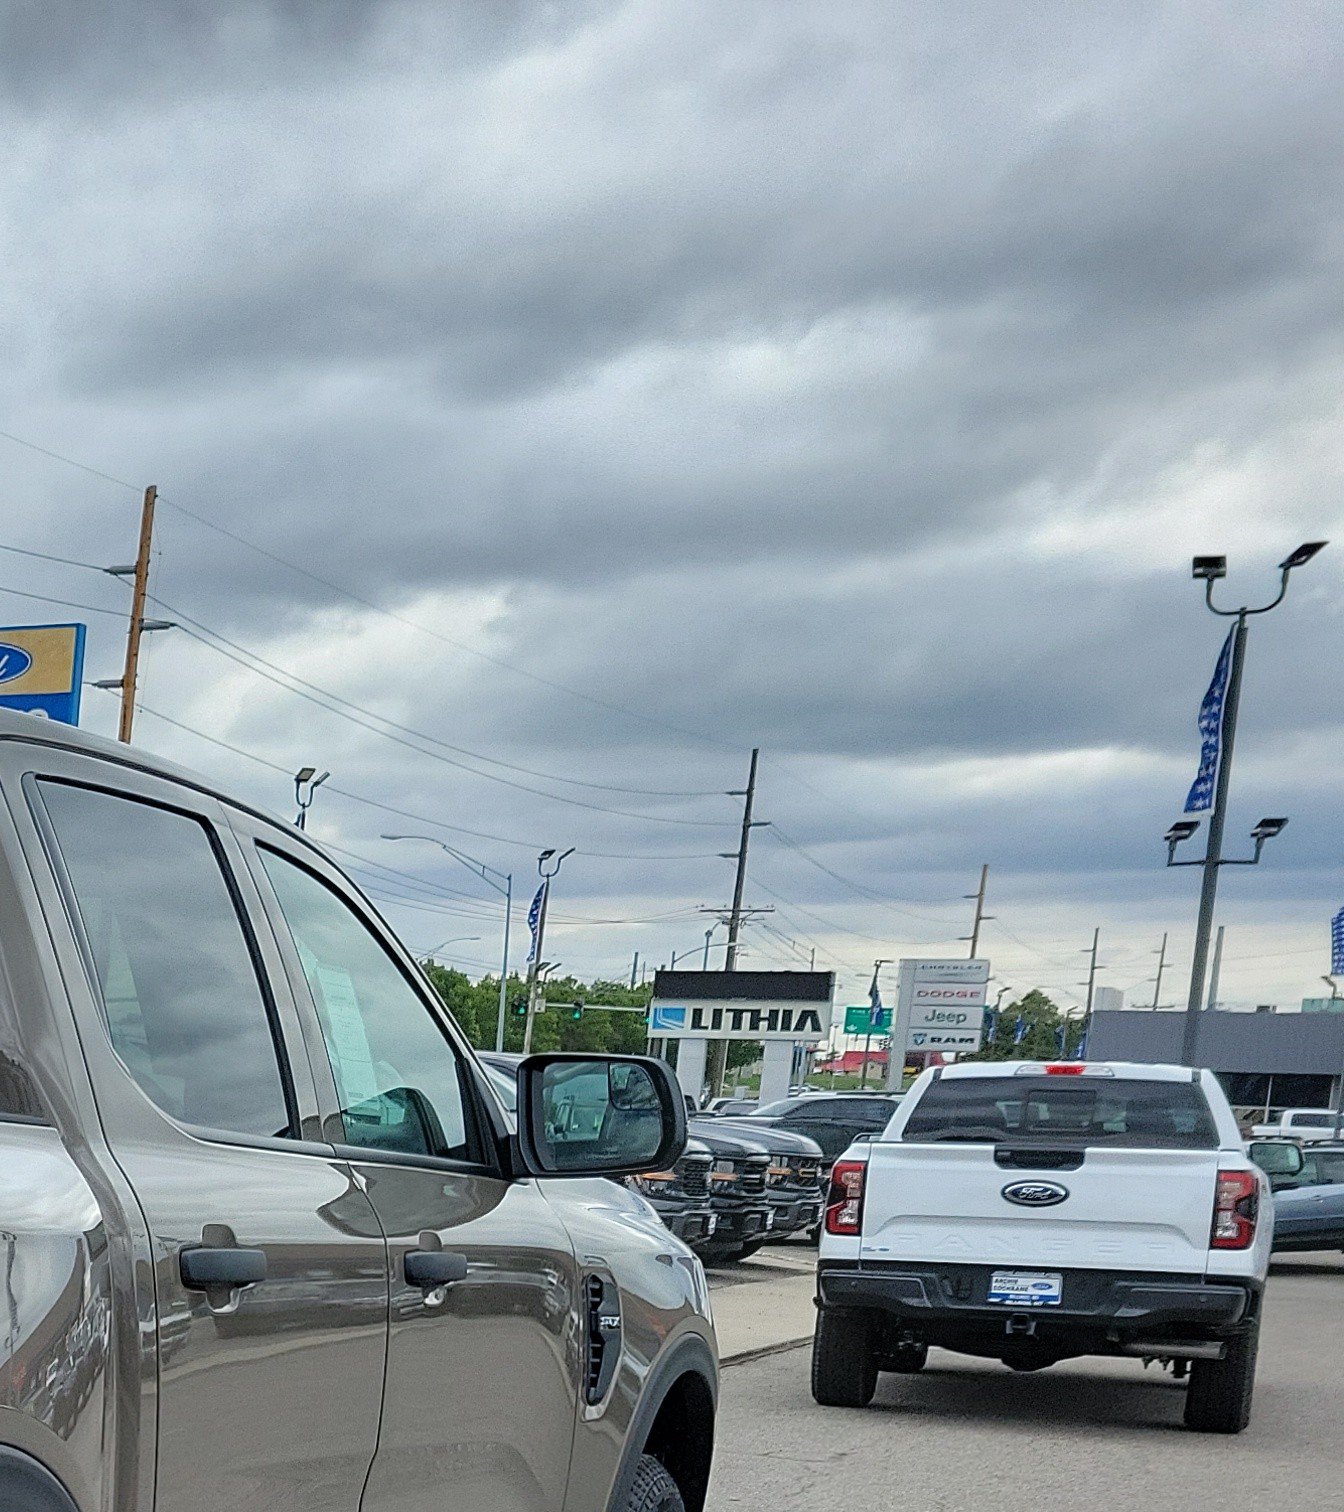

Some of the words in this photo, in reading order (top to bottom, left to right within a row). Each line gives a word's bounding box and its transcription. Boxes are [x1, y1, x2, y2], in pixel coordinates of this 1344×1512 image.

[917, 990, 981, 998] DODGE
[690, 1008, 823, 1033] LITHIA
[924, 1009, 967, 1025] Jeep
[930, 1036, 975, 1044] RAM
